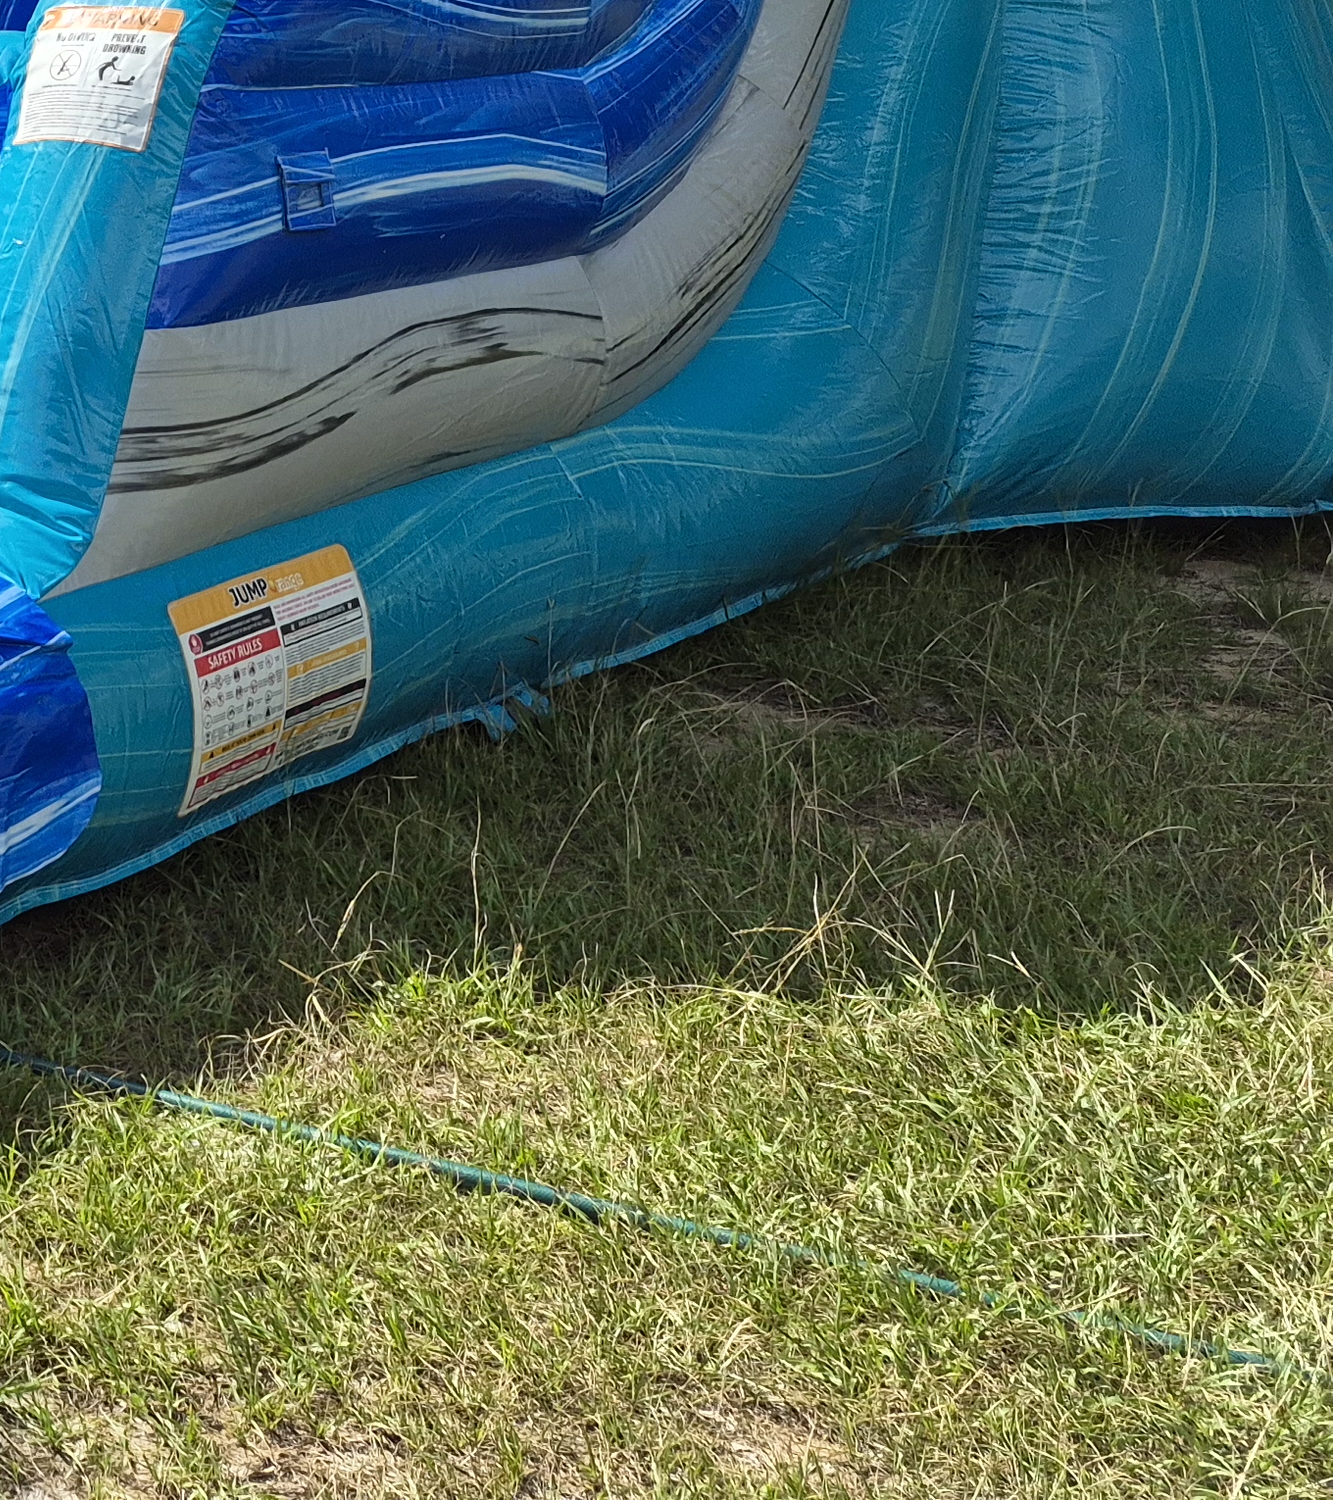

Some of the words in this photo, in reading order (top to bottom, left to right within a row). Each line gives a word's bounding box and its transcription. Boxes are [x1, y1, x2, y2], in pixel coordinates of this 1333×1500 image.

[111, 33, 147, 44] PREVET
[228, 577, 267, 607] JUMP
[207, 646, 236, 670] SAFETY
[237, 637, 263, 658] RULES
